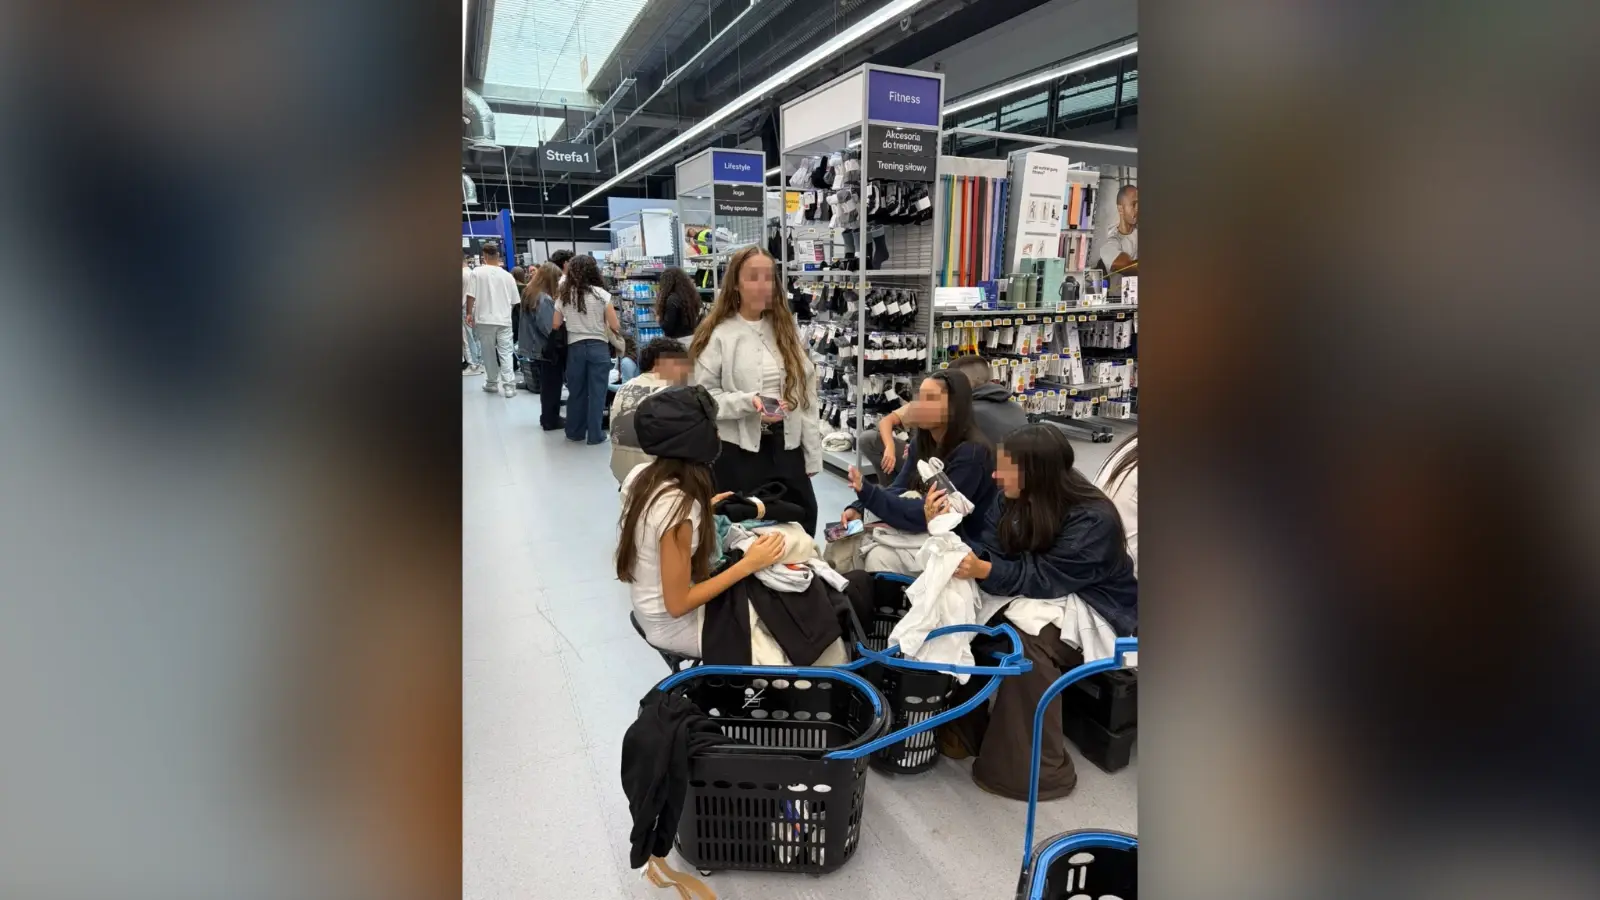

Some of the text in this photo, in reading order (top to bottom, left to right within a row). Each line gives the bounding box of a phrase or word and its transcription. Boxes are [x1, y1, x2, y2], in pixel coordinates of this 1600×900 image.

[889, 91, 921, 104] Fitness
[885, 129, 921, 141] Akcesoria
[882, 140, 923, 153] do treningu
[546, 149, 590, 163] Strefa 1
[724, 162, 751, 172] Lifestyle
[877, 160, 927, 174] Trening siłowy
[732, 189, 745, 197] Joga
[719, 203, 758, 212] Torby sportowe
